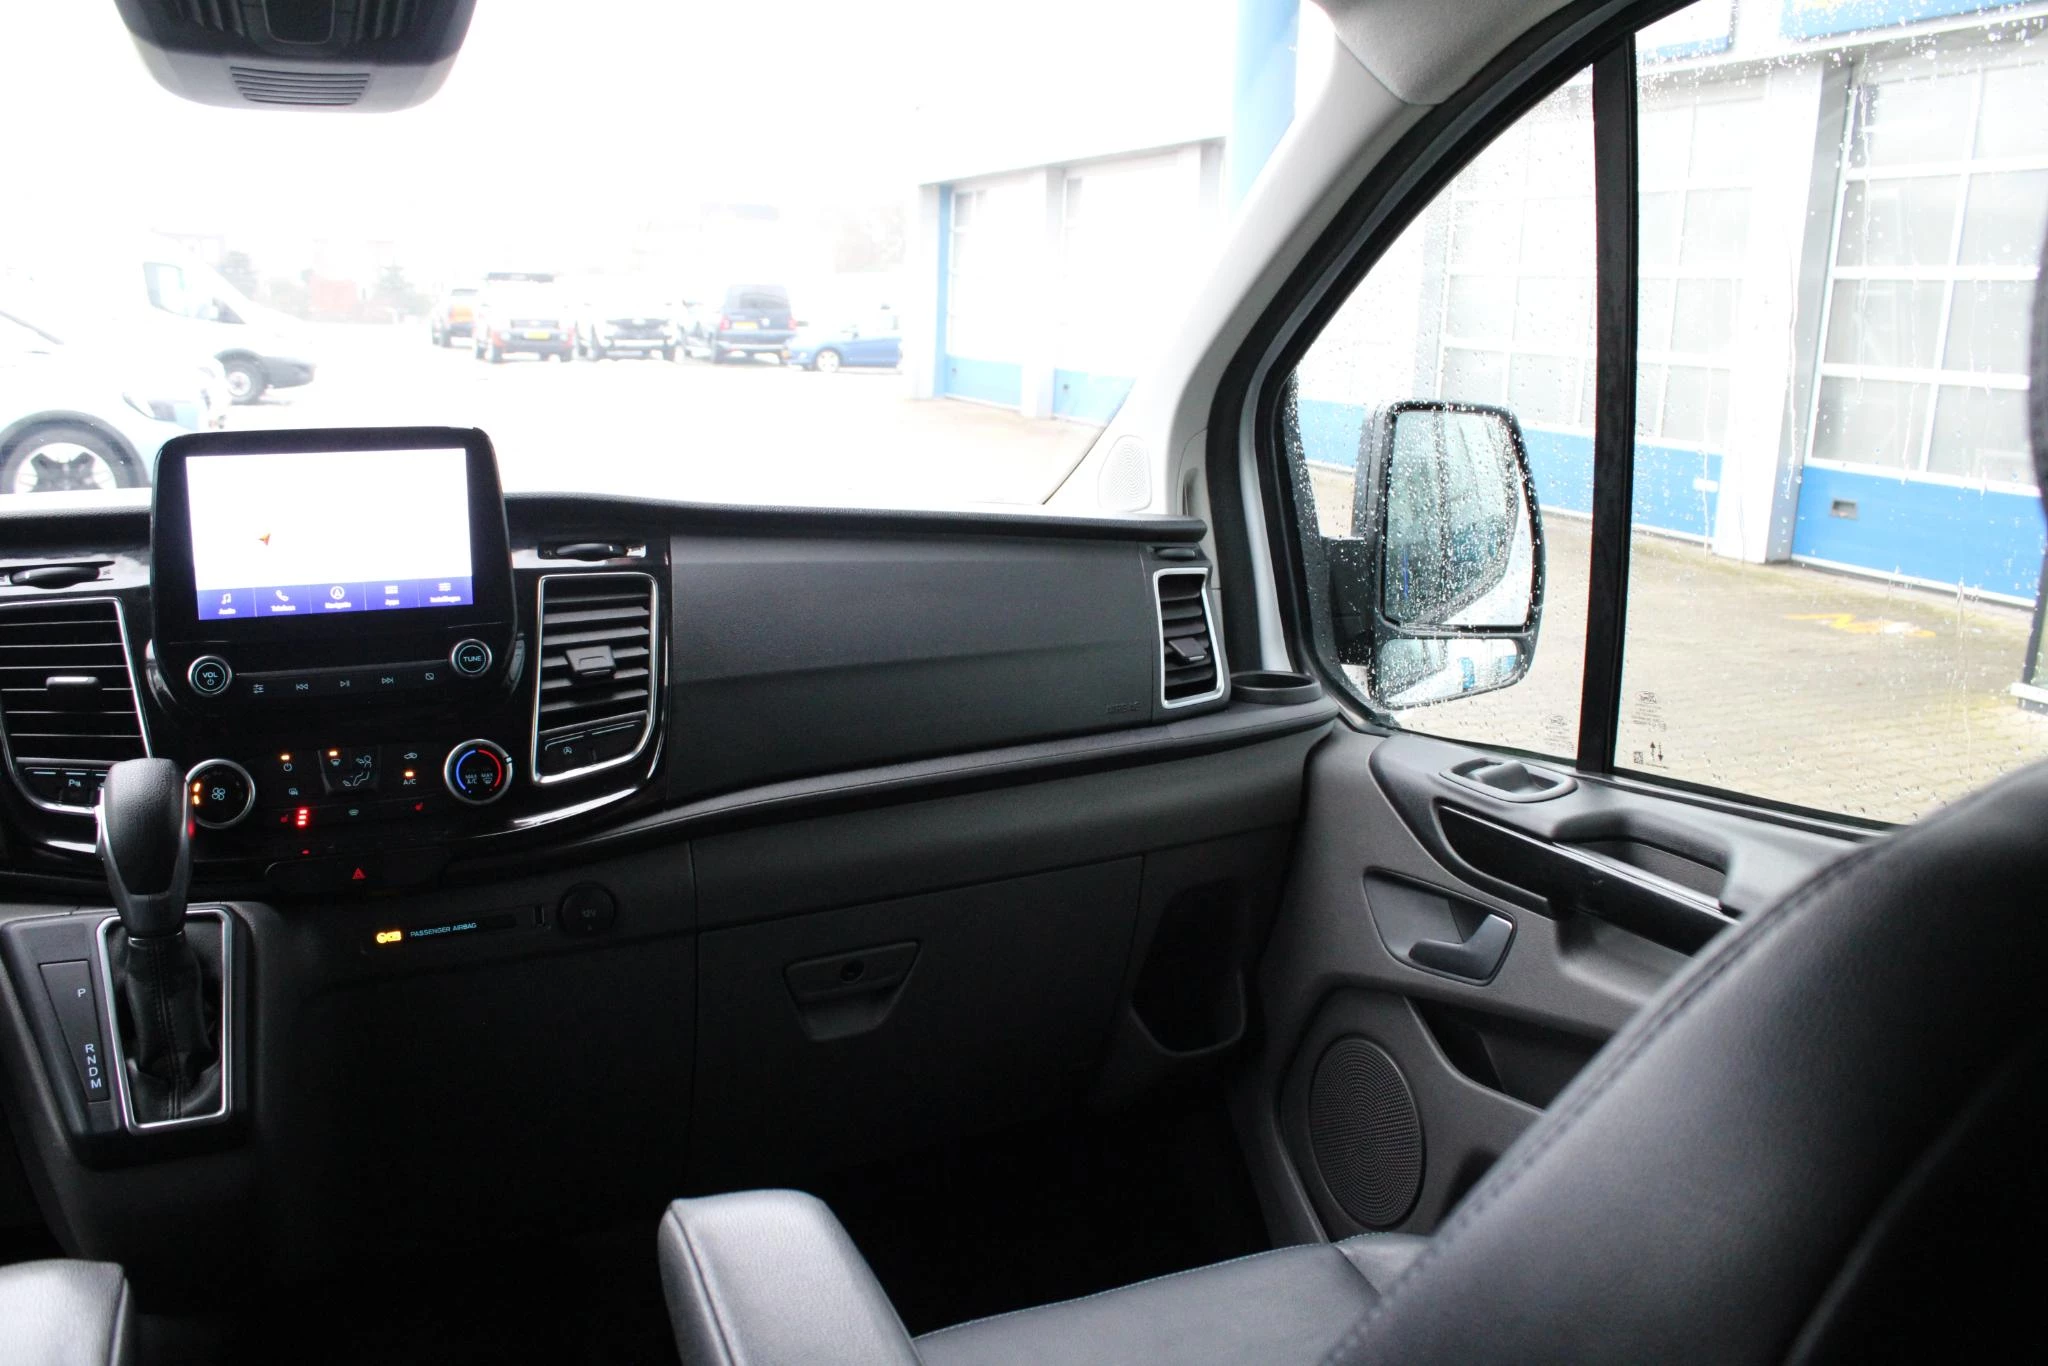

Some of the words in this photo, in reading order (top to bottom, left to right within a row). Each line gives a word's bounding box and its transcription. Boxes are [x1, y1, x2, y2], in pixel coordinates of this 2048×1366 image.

[410, 926, 450, 937] PASSENGER
[452, 922, 477, 932] AIRBAG
[77, 988, 86, 998] P
[85, 1043, 95, 1054] R
[87, 1054, 97, 1065] N
[88, 1066, 98, 1077] D
[90, 1078, 102, 1089] M
